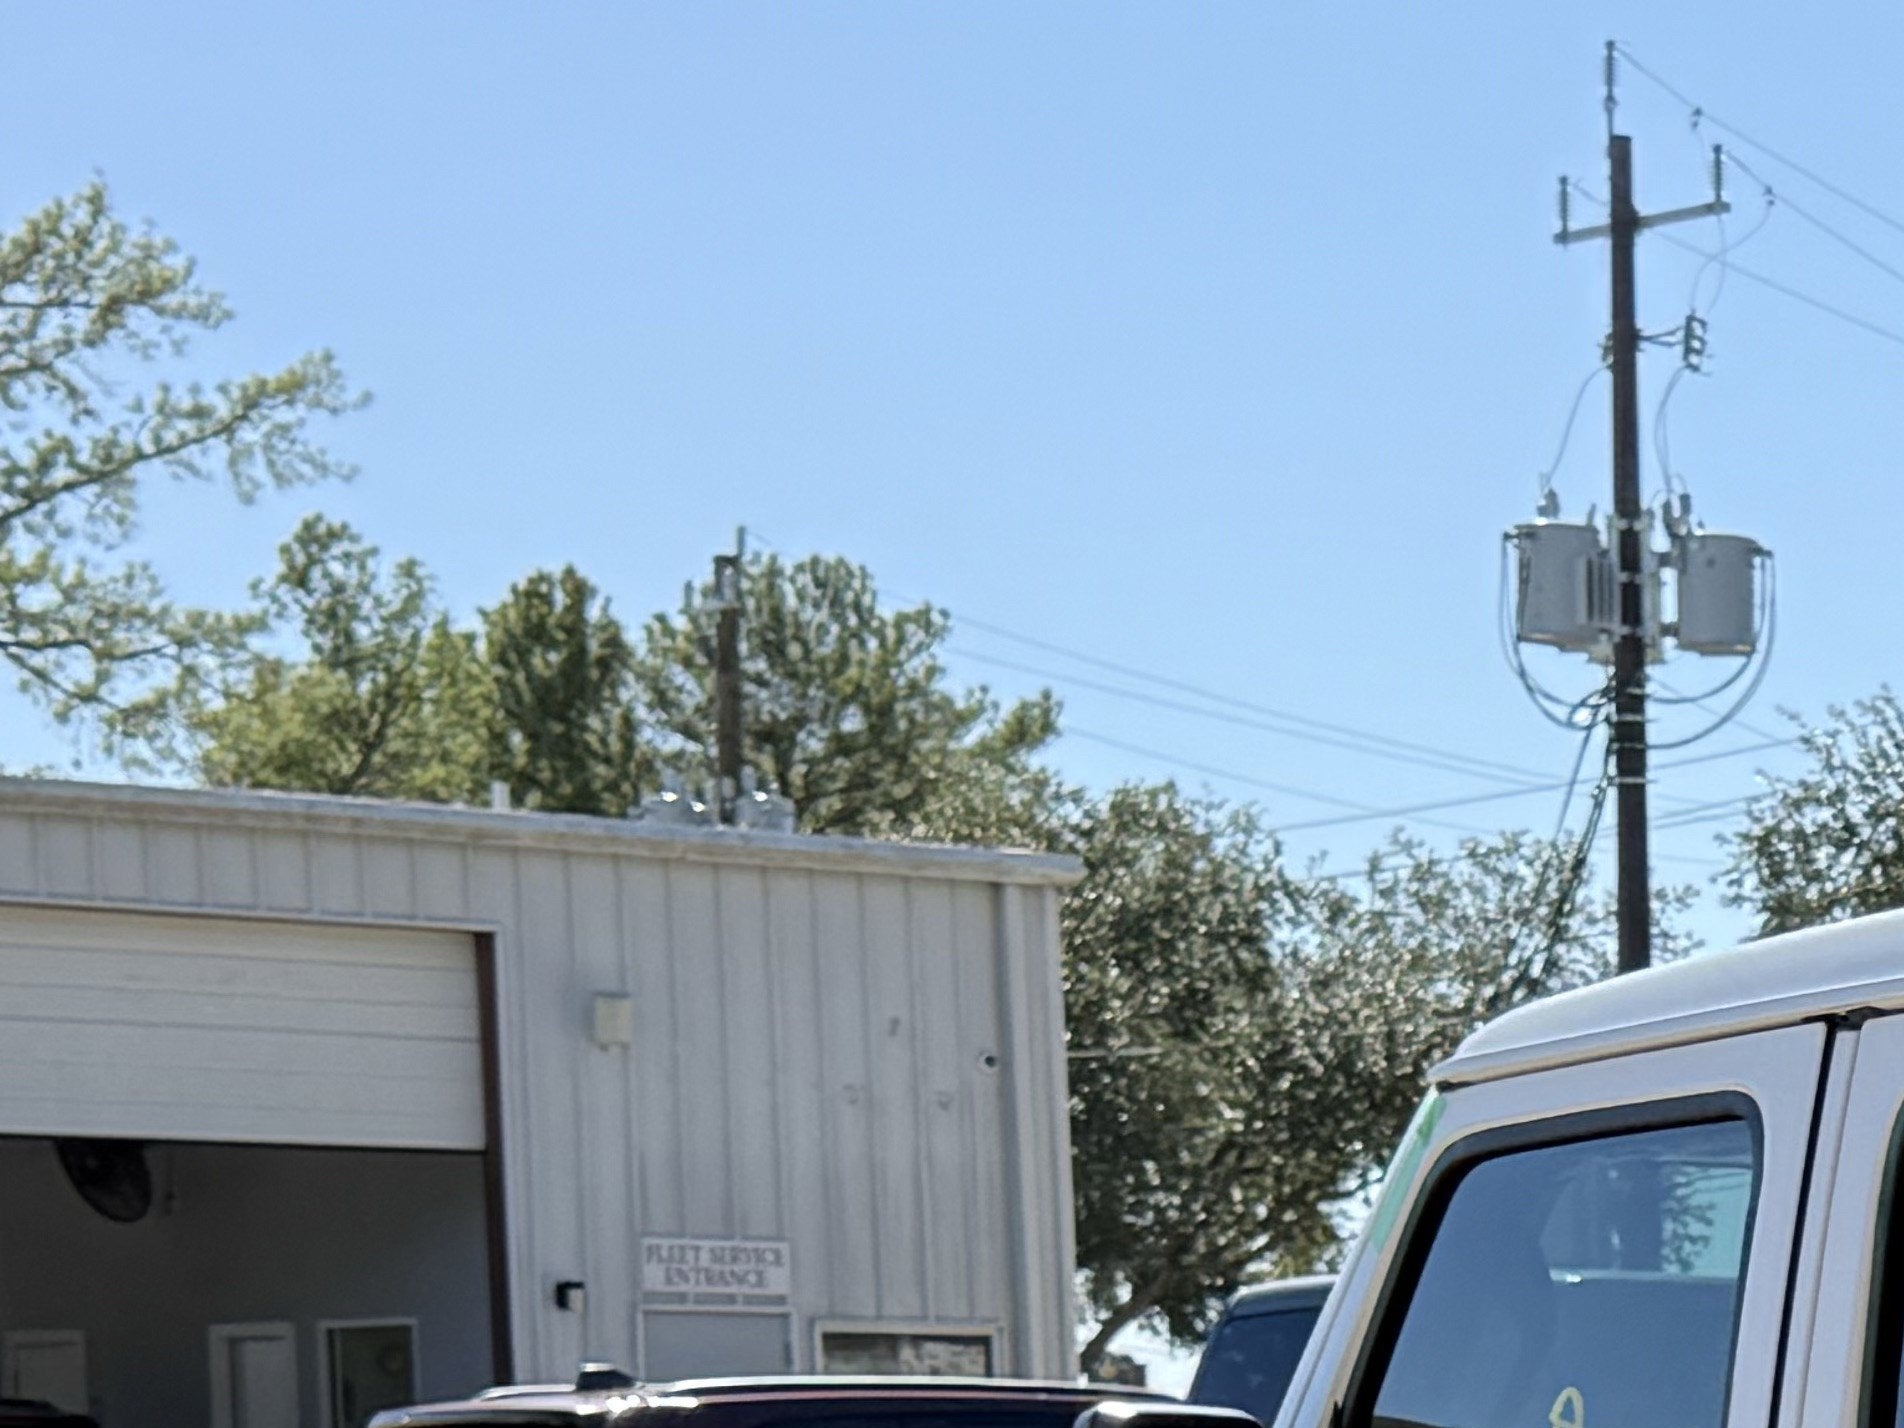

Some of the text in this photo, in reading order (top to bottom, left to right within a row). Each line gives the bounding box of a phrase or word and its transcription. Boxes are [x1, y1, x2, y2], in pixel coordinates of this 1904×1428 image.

[646, 1244, 785, 1267] FLEET SERVICE
[664, 1266, 768, 1288] ENTRANCE
